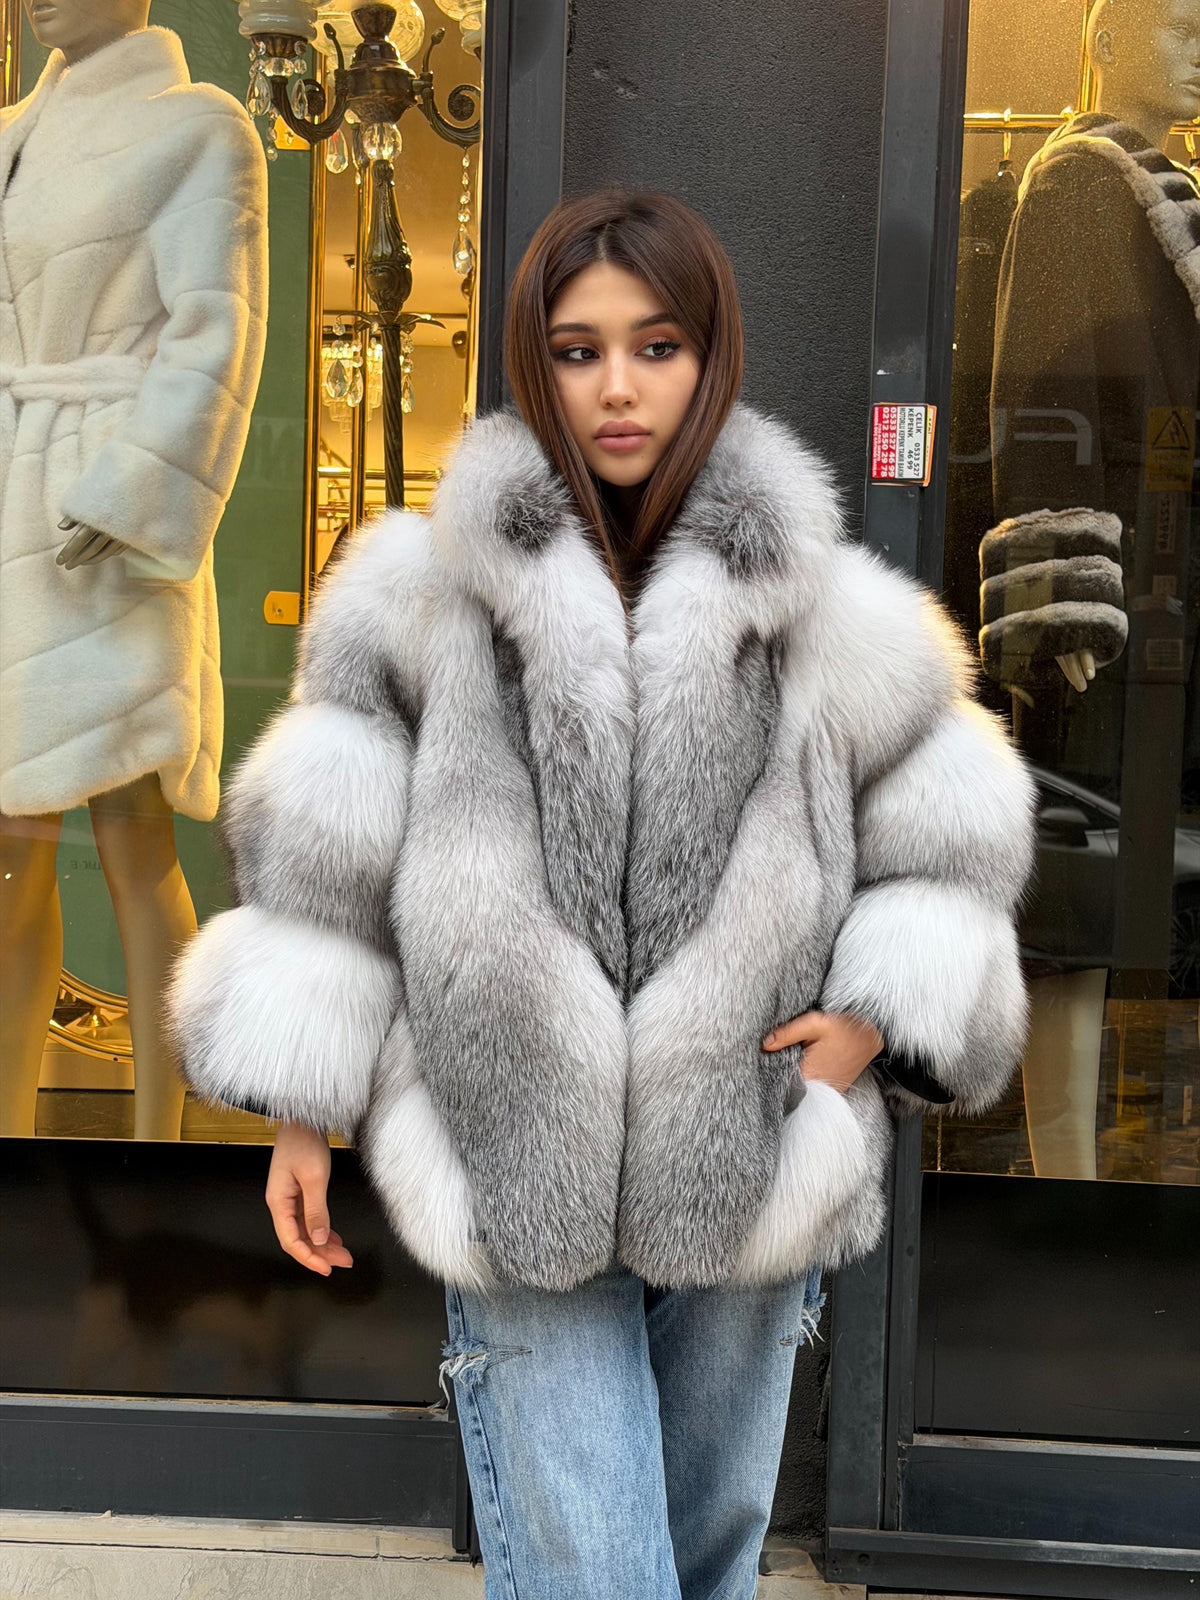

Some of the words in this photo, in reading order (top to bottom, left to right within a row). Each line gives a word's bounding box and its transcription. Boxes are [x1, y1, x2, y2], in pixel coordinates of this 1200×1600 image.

[881, 452, 887, 464] 29
[889, 452, 895, 464] 46
[907, 449, 913, 459] 46
[880, 465, 887, 477] 78
[888, 465, 895, 477] 99
[907, 460, 913, 470] 99
